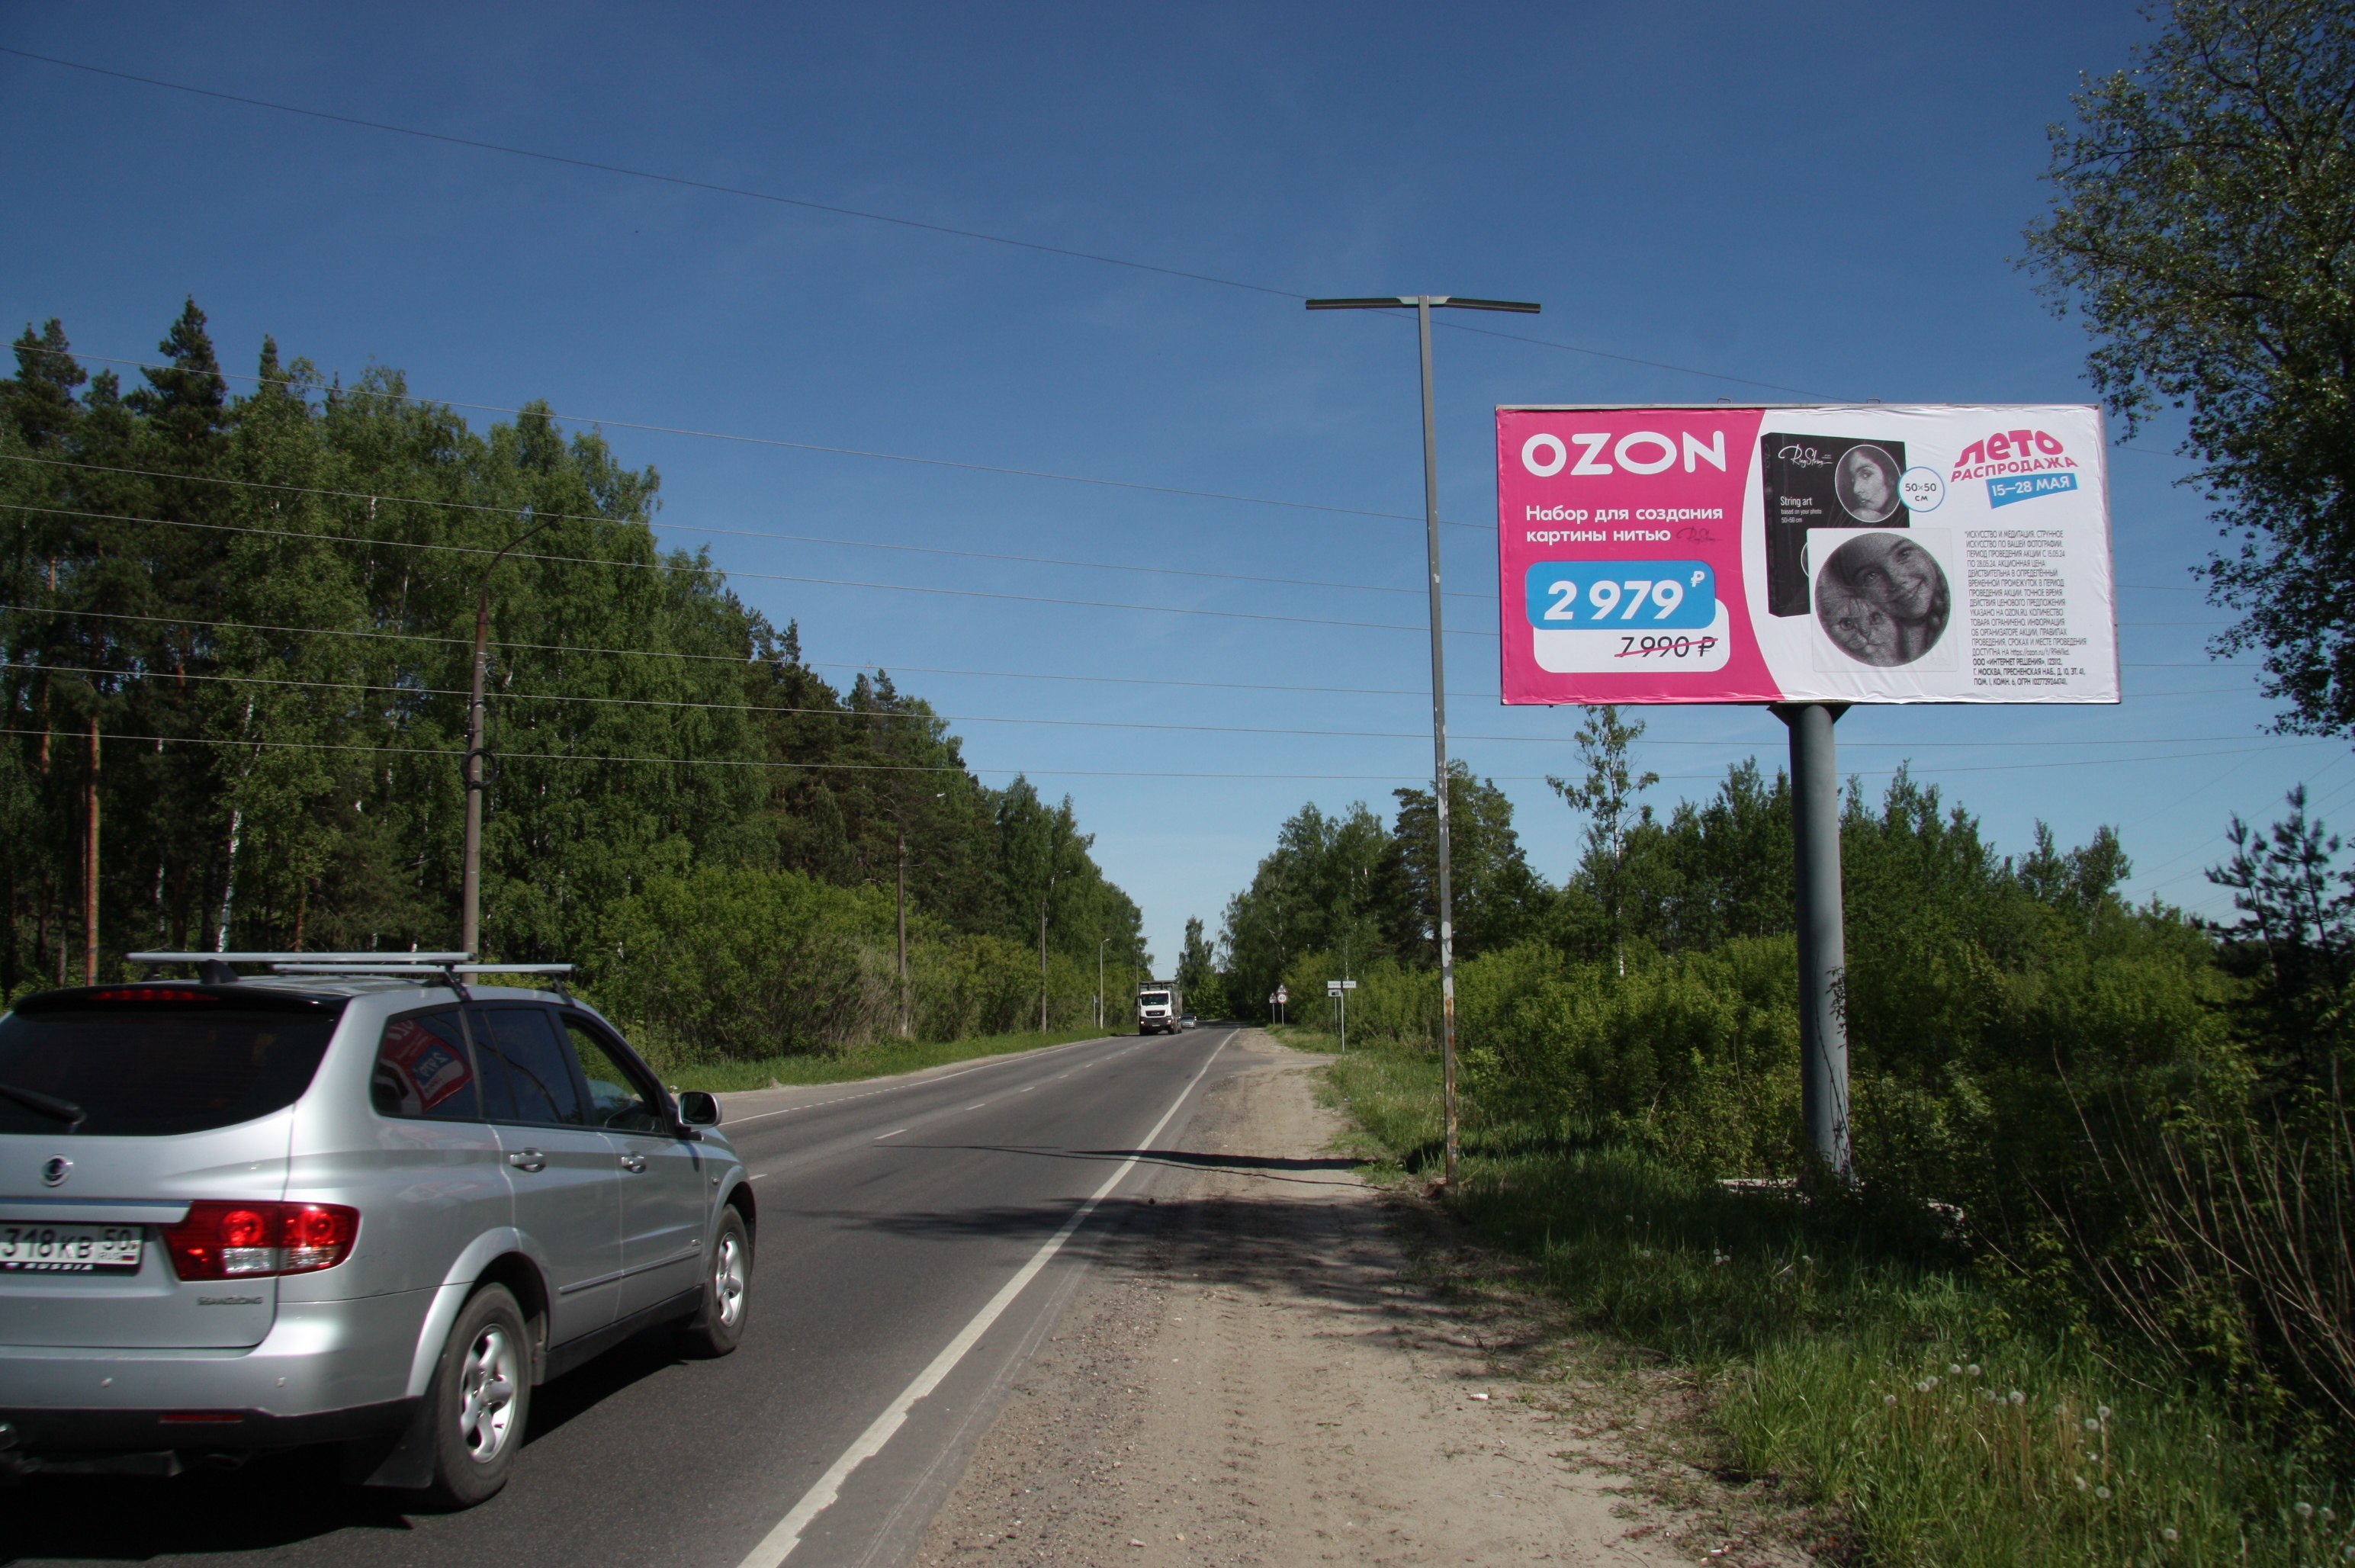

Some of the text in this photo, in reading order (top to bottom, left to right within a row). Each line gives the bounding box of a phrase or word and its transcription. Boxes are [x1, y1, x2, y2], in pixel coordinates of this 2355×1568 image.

[1521, 431, 1727, 477] OZON
[1950, 456, 2079, 482] РАСПРОДАЖА
[2035, 476, 2071, 493] МАЯ
[1780, 496, 1812, 508] String art
[1526, 505, 1723, 523] Набор для создания
[1526, 529, 1606, 545] картины
[1613, 529, 1671, 542] нитью
[1589, 580, 1683, 620] 979
[1970, 599, 2065, 607] ДЕЙСТВИЯ ЦЕНОВОГО ПРЕДЛОЖЕНИЯ
[103, 1228, 133, 1250] 50
[23, 1263, 93, 1271] RUSSIA
